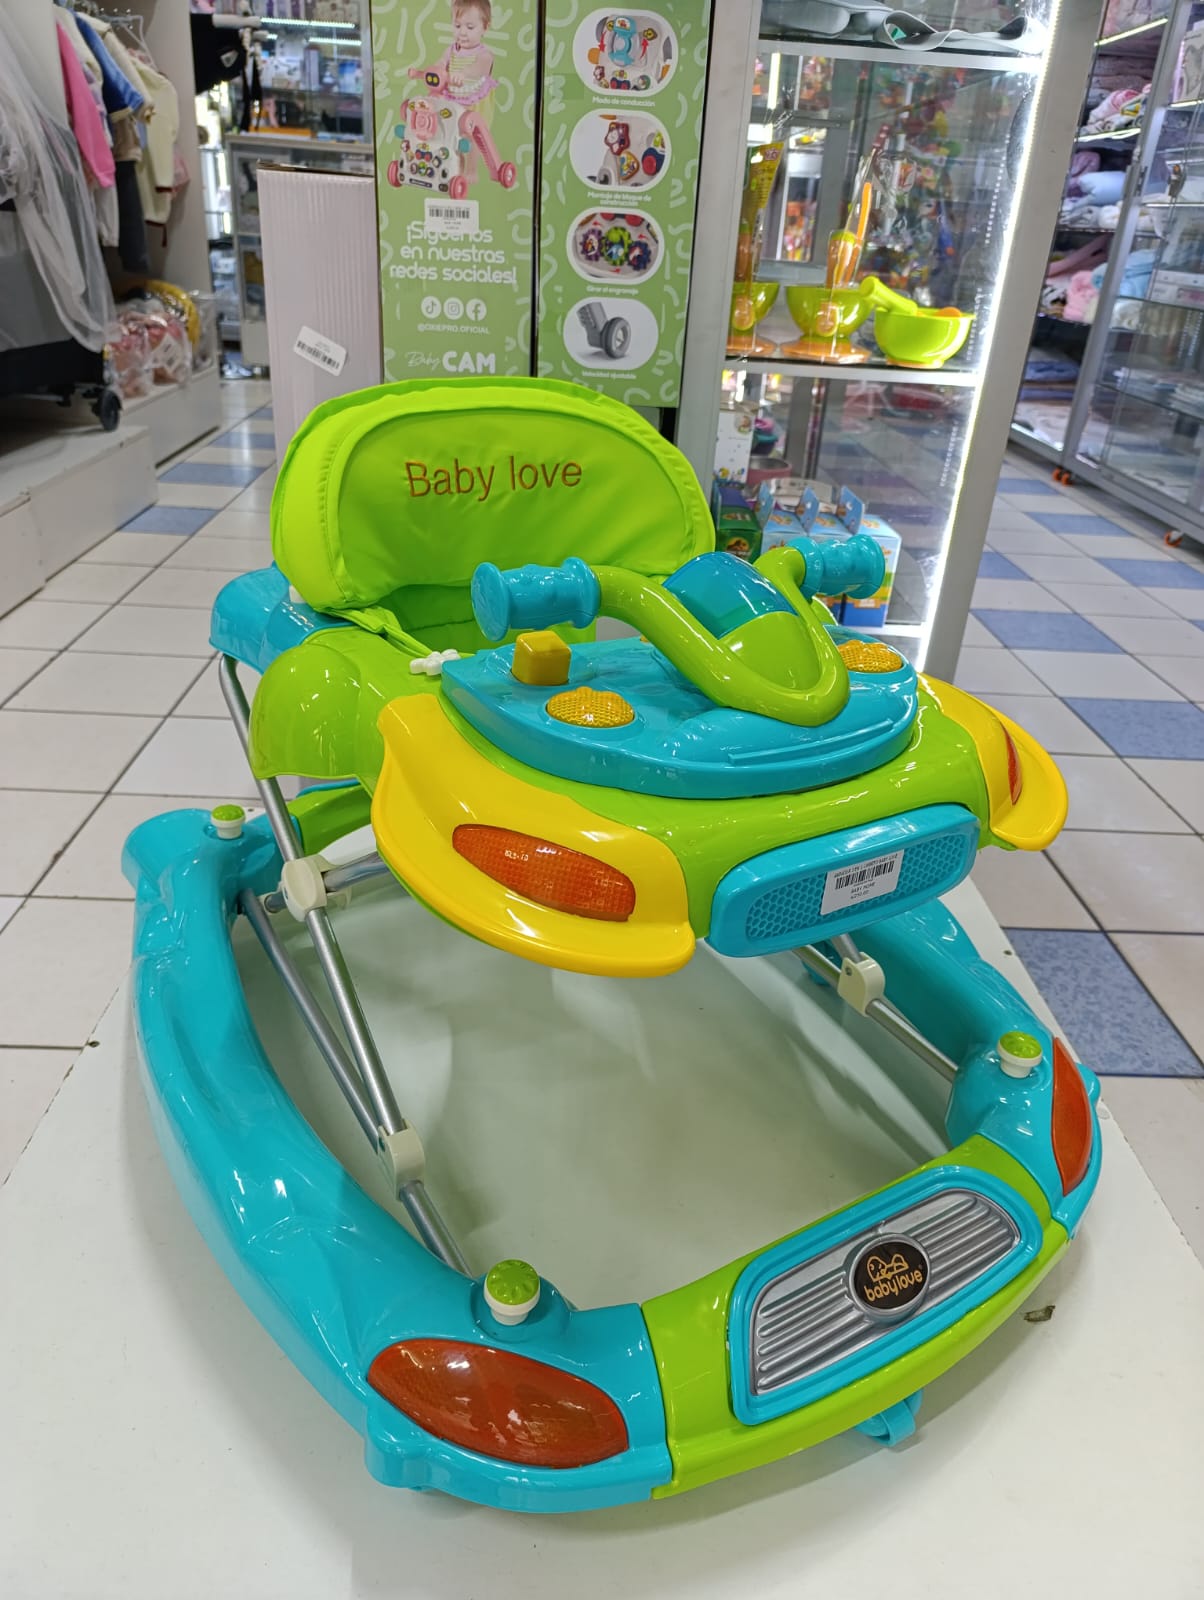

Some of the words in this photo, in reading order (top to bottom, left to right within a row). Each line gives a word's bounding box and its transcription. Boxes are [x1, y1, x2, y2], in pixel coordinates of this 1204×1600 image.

[400, 245, 423, 259] en
[428, 244, 505, 264] nuestras
[390, 261, 438, 280] redes
[442, 264, 517, 284] sociales!
[442, 350, 496, 374] CAM
[405, 457, 495, 502] Baby
[509, 455, 583, 492] love
[863, 1269, 923, 1302] babylove
